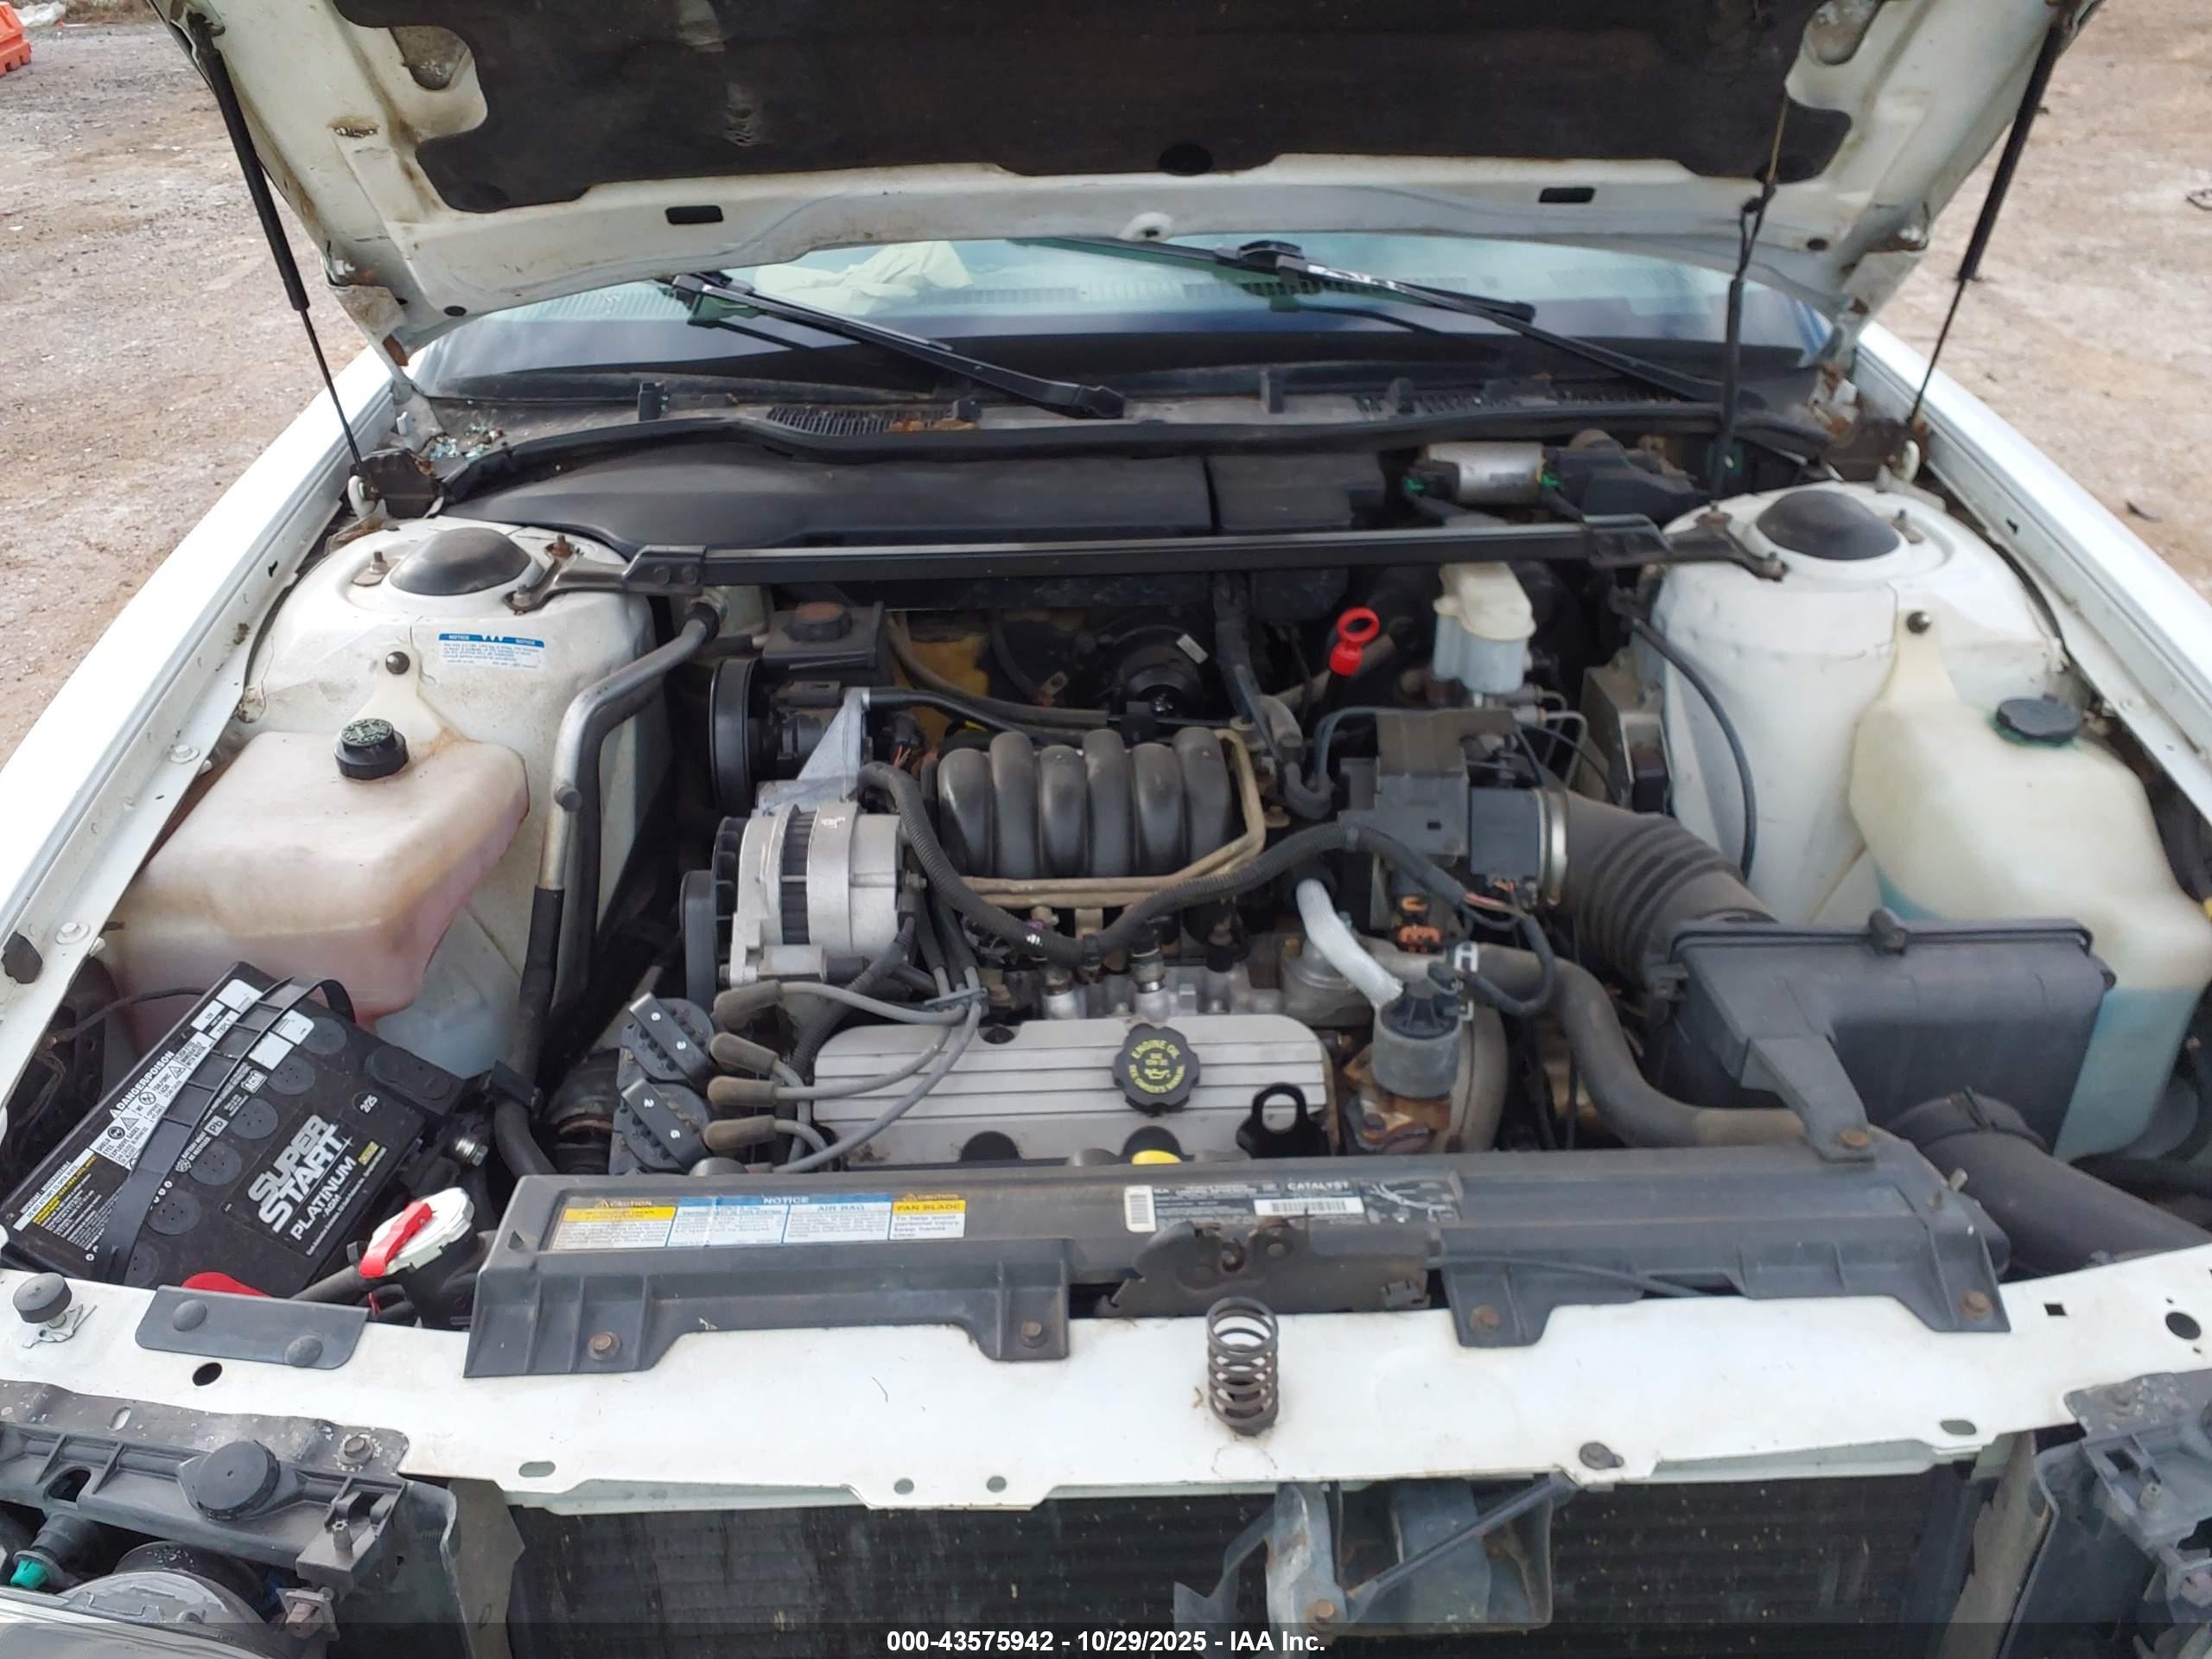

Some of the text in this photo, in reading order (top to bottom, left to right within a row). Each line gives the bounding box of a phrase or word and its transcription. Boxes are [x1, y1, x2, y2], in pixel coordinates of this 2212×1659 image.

[1131, 1039, 1167, 1059] ENGINE
[1166, 1044, 1181, 1059] OIL
[114, 1050, 175, 1109] DANGER/POISON
[243, 1072, 264, 1090] AGM
[359, 1095, 378, 1115] 2/25
[207, 1118, 225, 1133] Pb
[96, 1137, 111, 1151] SHIELD
[107, 1126, 140, 1158] EXPLOSIVE GASES
[180, 1131, 207, 1158] BATTERY MUST
[248, 1115, 338, 1202] SUPER
[258, 1123, 343, 1232] START
[1287, 1181, 1350, 1191] CATALYST
[18, 1192, 41, 1213] IMPORTANT
[30, 1204, 41, 1212] NOT
[37, 1189, 54, 1205] ATTEMPT
[56, 1174, 68, 1185] OPEN
[290, 1156, 357, 1241] PLATINUM
[763, 1196, 810, 1205] NOTICE
